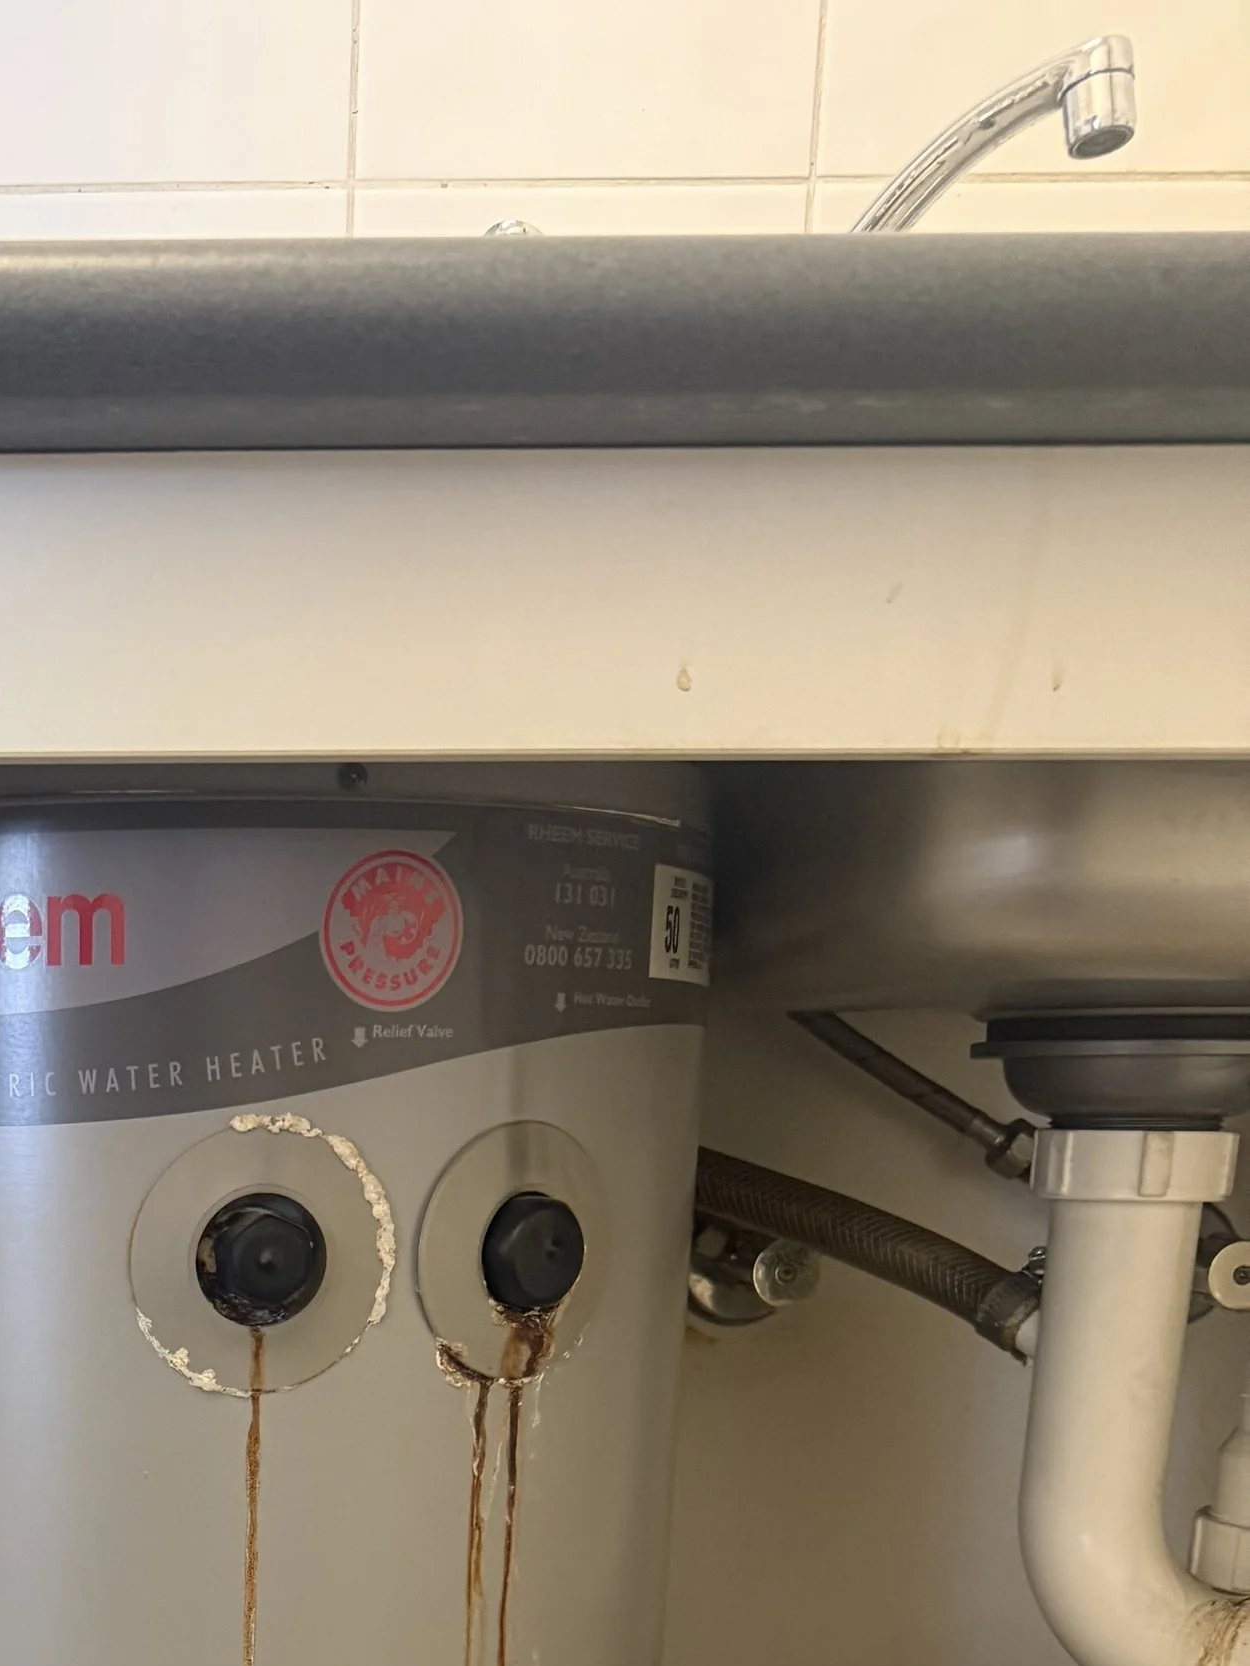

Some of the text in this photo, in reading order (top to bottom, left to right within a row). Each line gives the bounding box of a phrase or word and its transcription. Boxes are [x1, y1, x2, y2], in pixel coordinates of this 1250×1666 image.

[528, 823, 640, 850] RHEEM SERVICE
[350, 865, 437, 904] MAINS
[555, 881, 616, 908] 131 031
[544, 924, 575, 942] New
[664, 904, 680, 954] 50
[340, 940, 440, 991] PRESSURE
[523, 943, 633, 970] 0800 657 335
[372, 1023, 454, 1039] Relief Valve
[78, 1060, 183, 1095] WATER
[206, 1037, 327, 1082] HEATER
